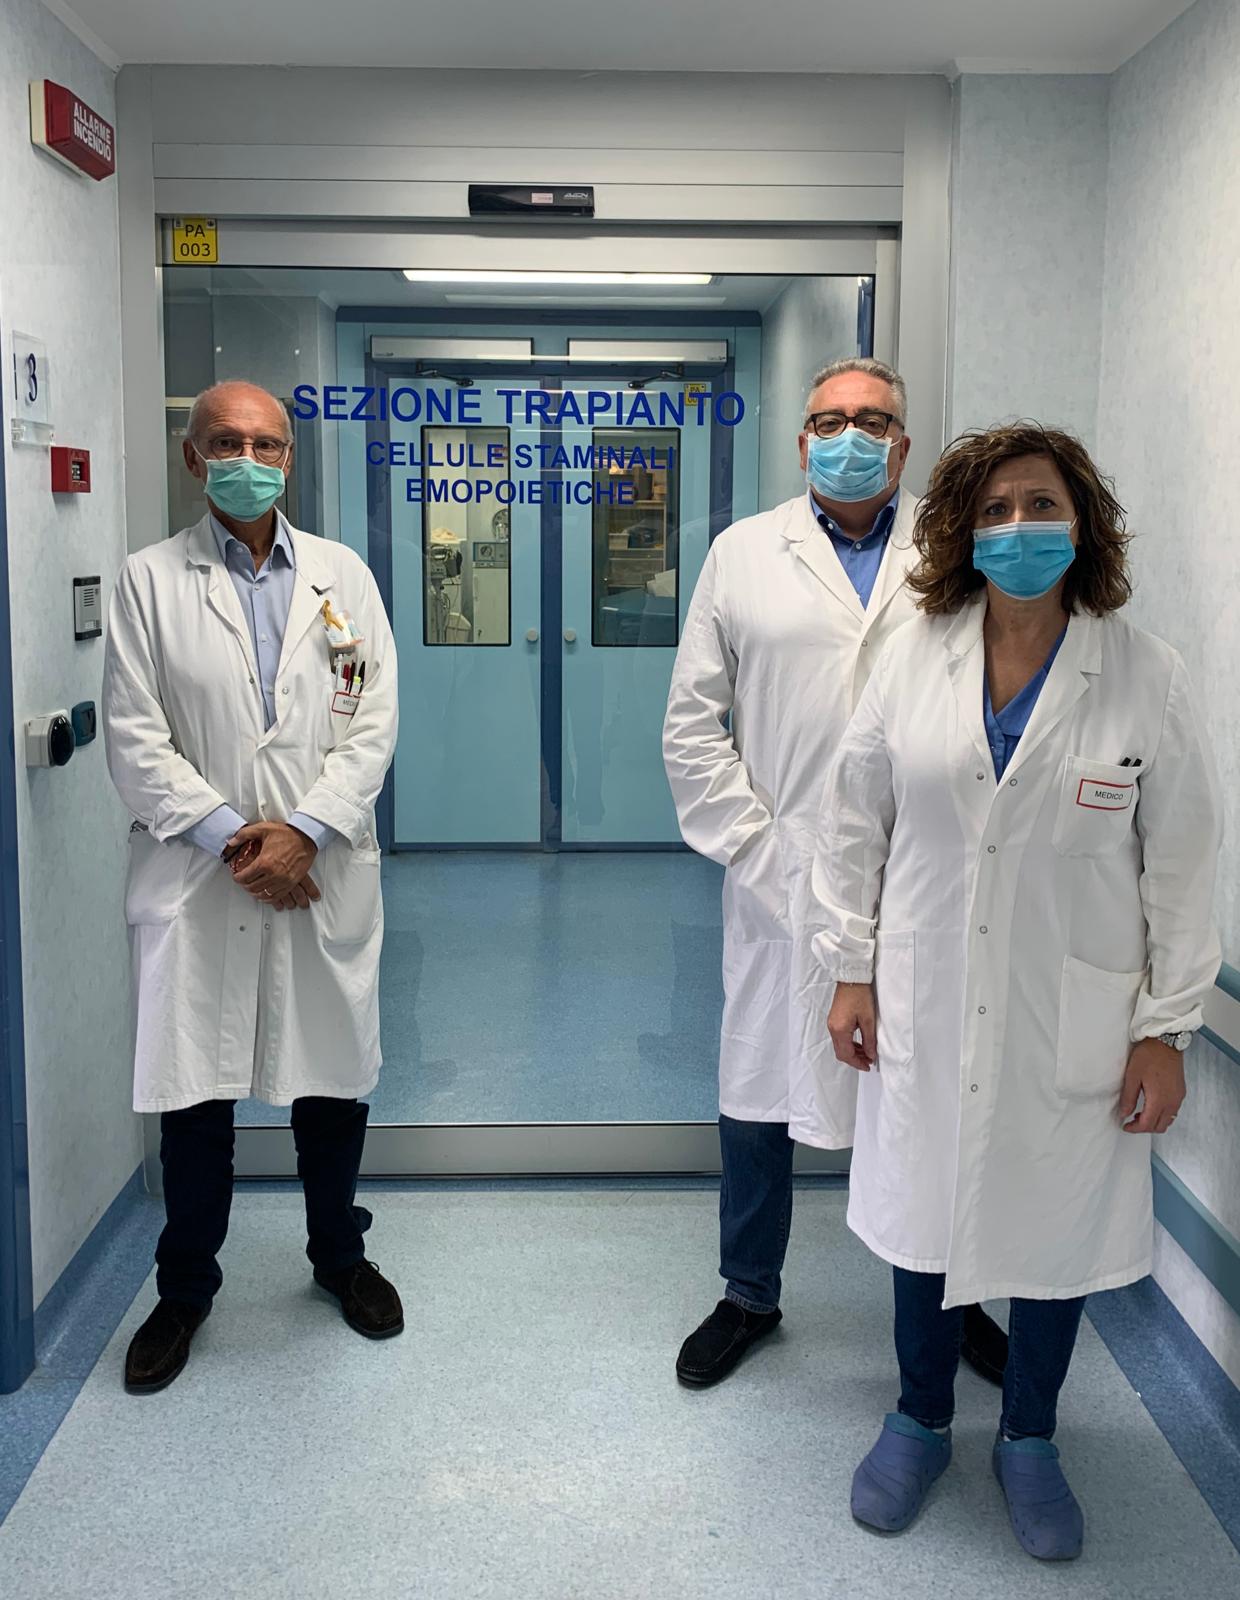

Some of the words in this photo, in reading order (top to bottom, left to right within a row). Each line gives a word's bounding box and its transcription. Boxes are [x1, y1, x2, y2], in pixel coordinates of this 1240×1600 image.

[74, 102, 111, 145] ALLARME
[74, 119, 111, 162] INCENDIO
[185, 224, 206, 238] PA
[180, 243, 211, 257] 003
[293, 385, 482, 423] SEZIONE
[496, 389, 745, 427] TRAPIANTO
[366, 441, 504, 468] CELLULE
[514, 444, 674, 470] STAMINALI
[406, 479, 635, 506] EMOPOIETICHE
[1094, 790, 1124, 800] MEDICO
